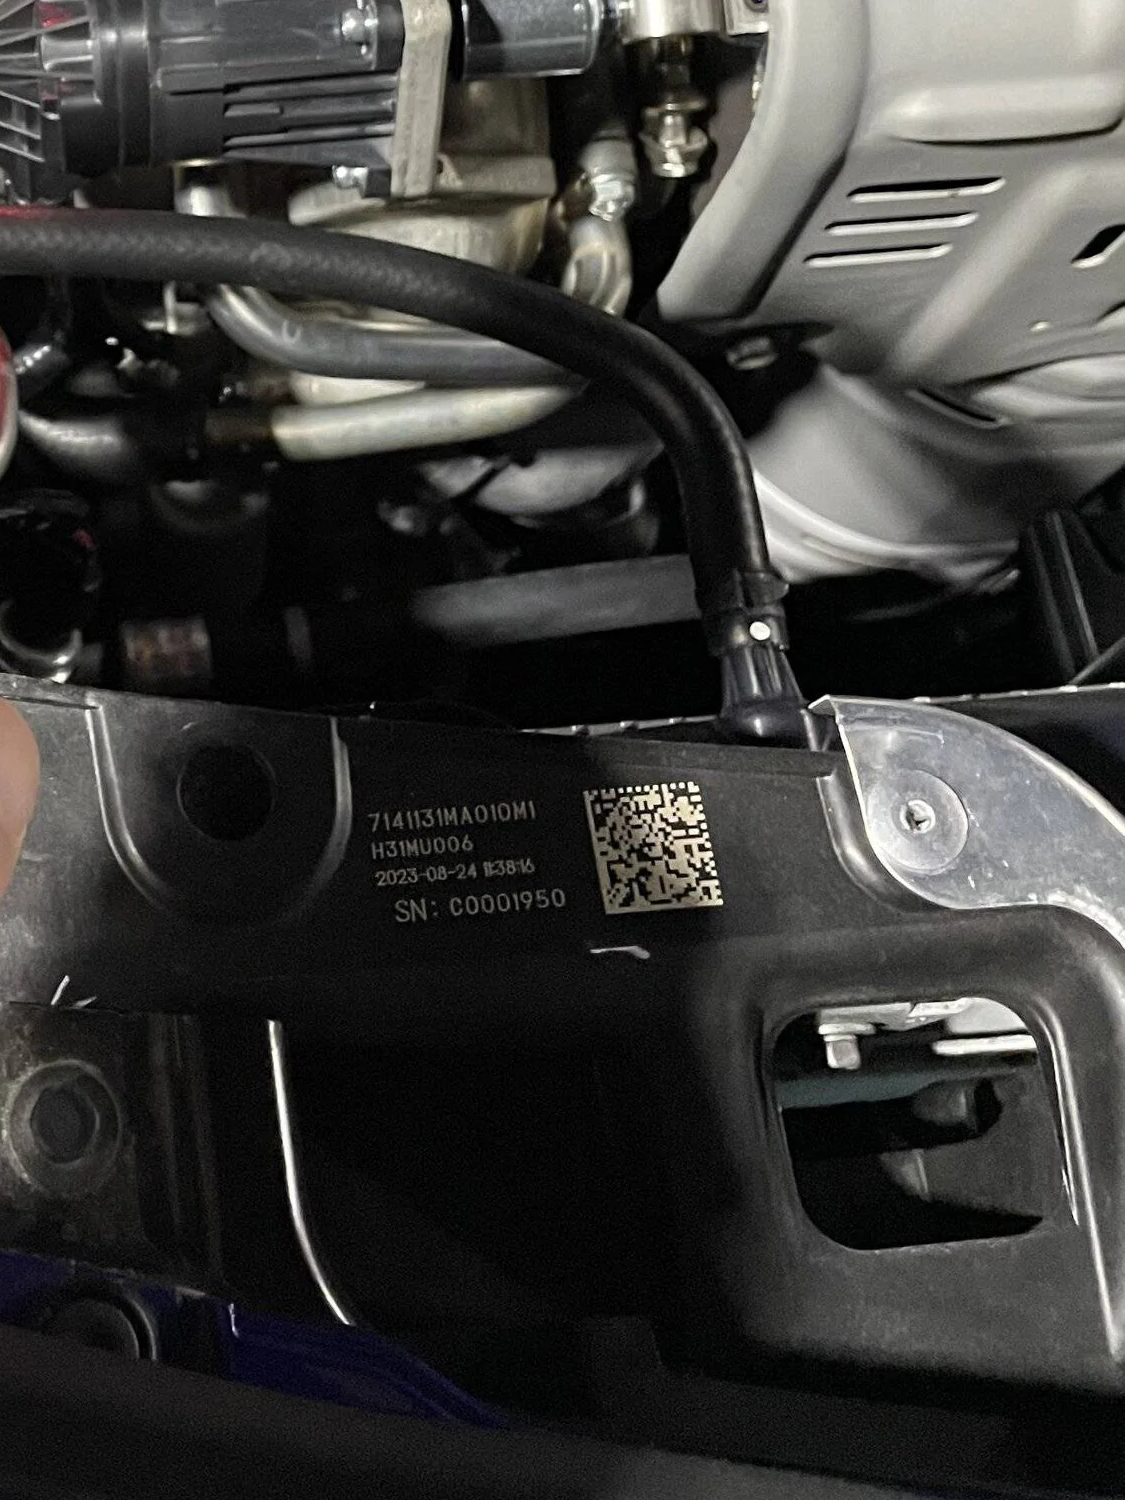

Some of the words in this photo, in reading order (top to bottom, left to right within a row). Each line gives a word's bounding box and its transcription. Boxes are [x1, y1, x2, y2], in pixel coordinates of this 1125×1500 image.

[371, 834, 474, 860] H31MU006
[375, 862, 478, 887] 2023-08-24
[394, 897, 439, 923] SN:
